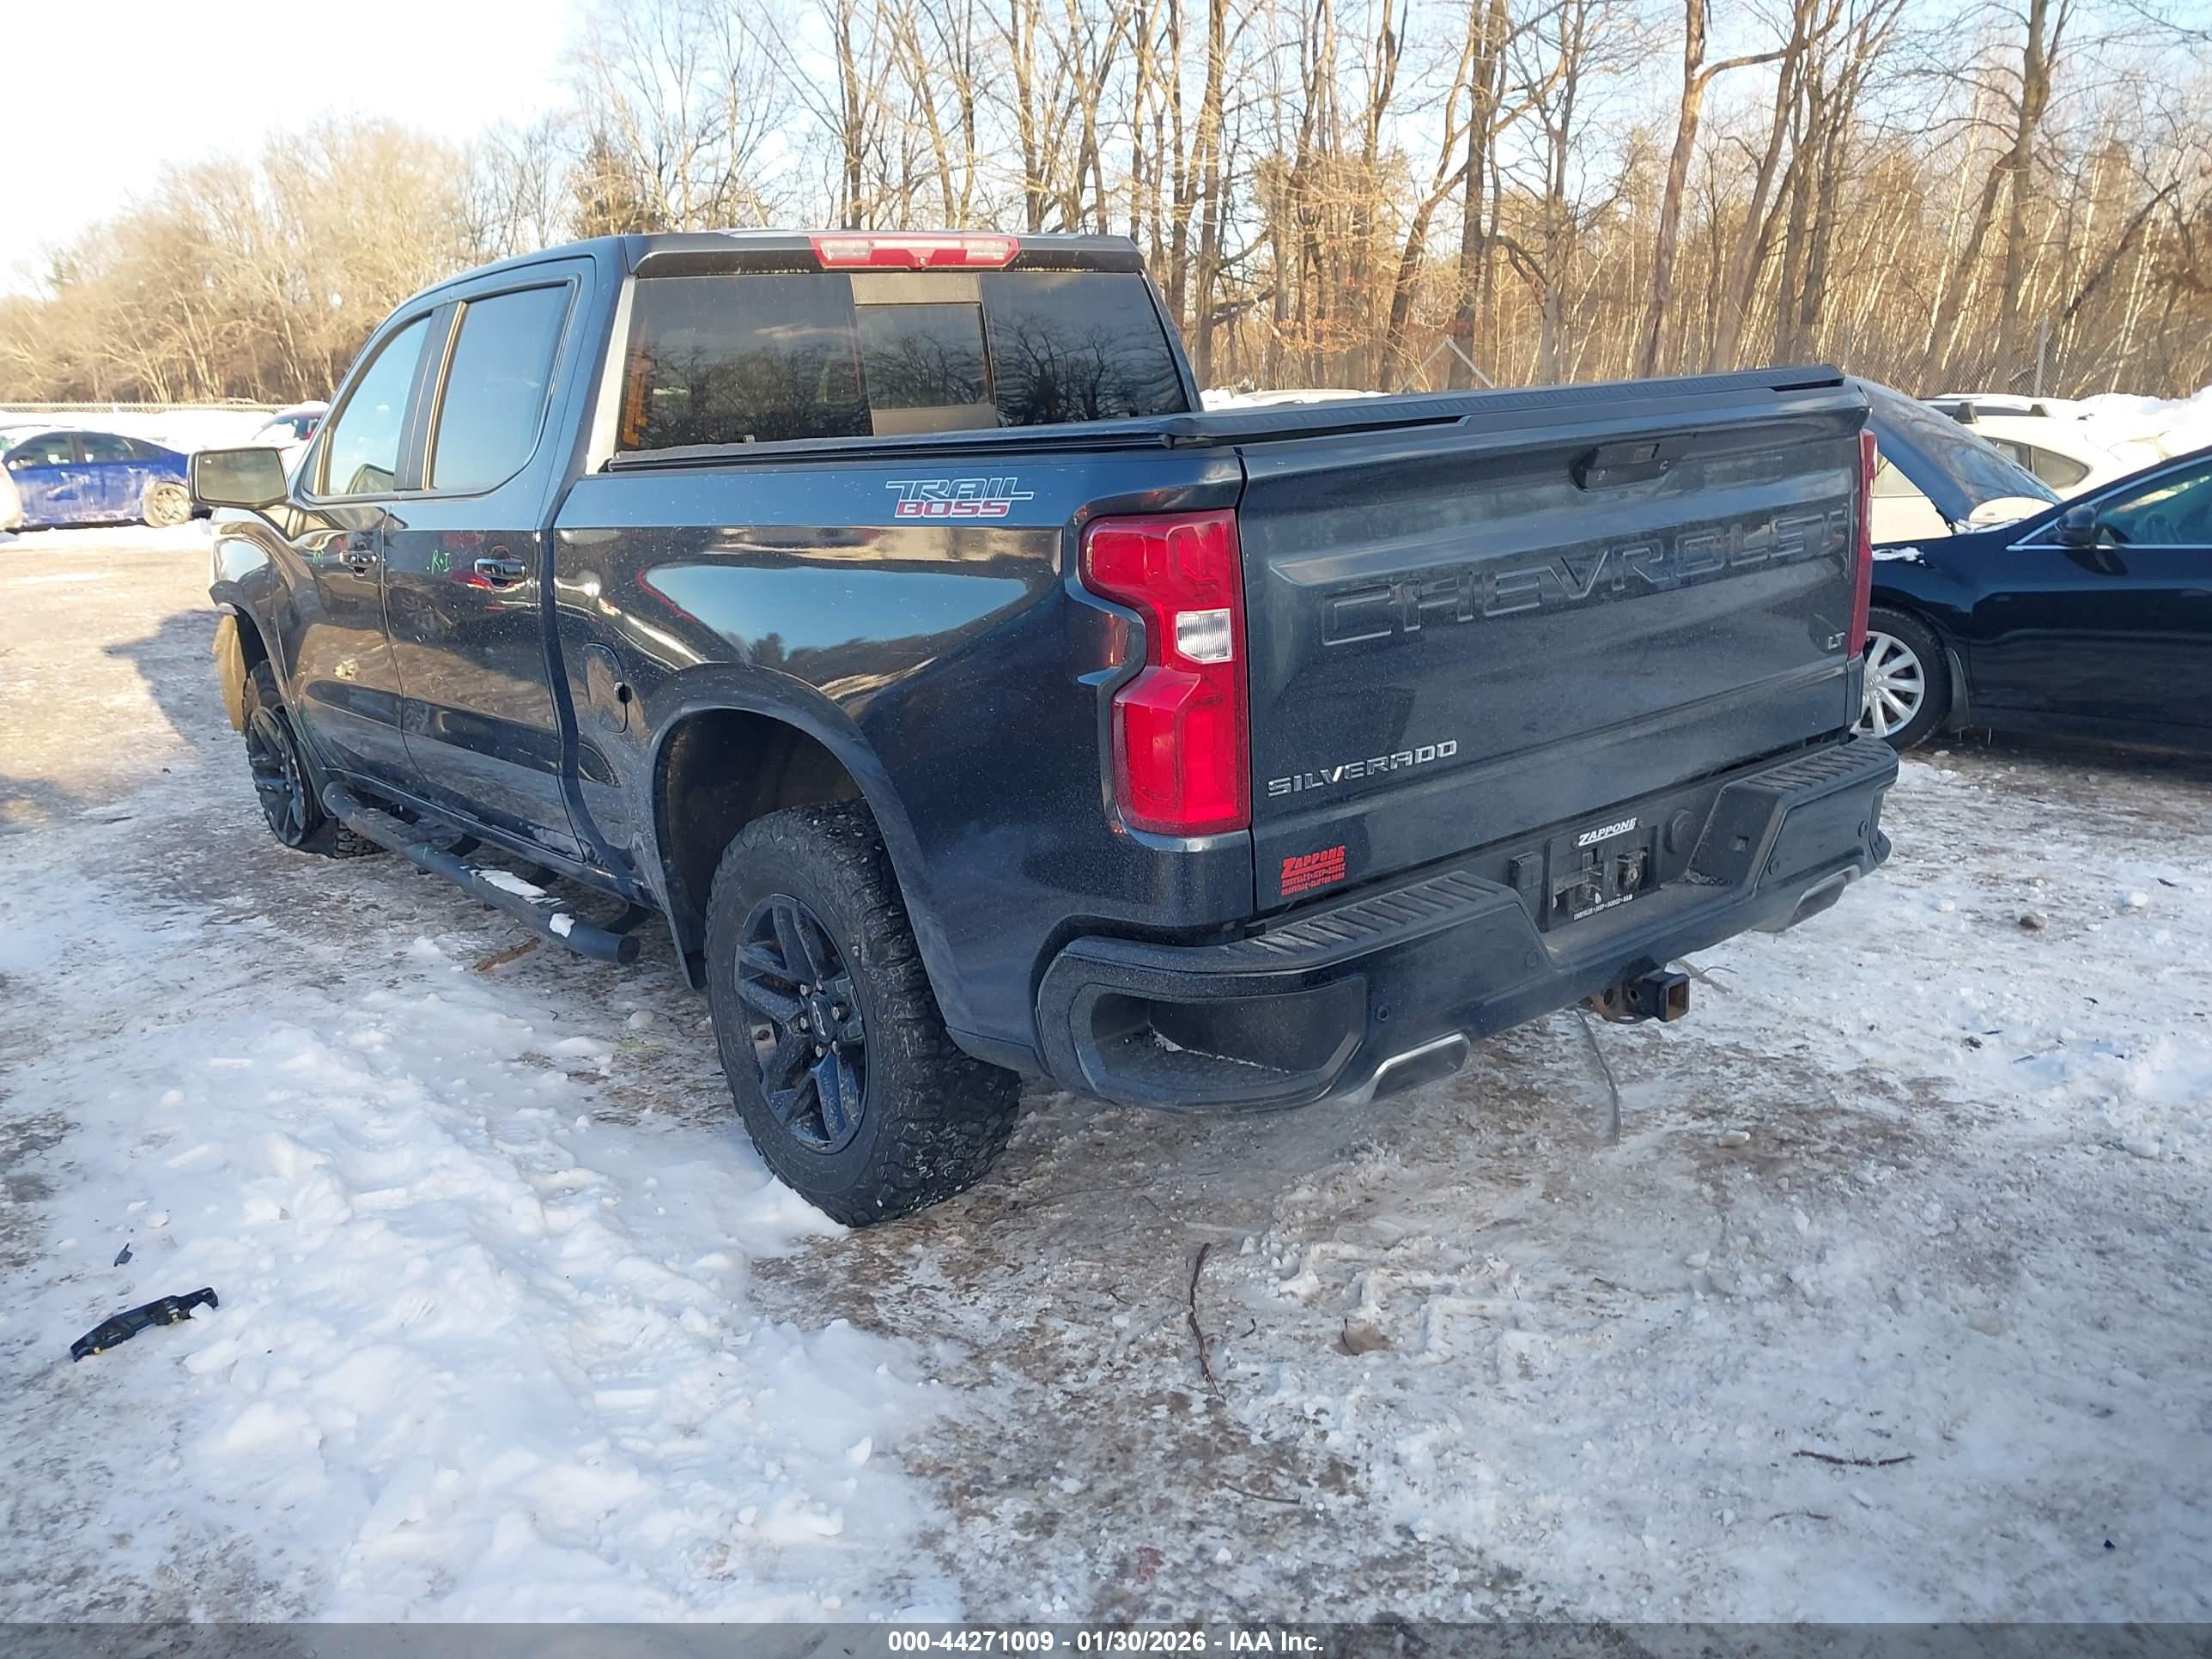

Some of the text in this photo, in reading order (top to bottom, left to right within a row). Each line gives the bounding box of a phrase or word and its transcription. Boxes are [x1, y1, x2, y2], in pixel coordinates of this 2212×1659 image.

[885, 477, 1035, 501] TRAIL
[894, 499, 1011, 519] BOSS
[1322, 504, 1849, 647] CHEVROLET
[1827, 631, 1846, 650] LT
[1267, 739, 1458, 798] SILVERADO
[1578, 817, 1638, 847] ZAPPONE
[1281, 845, 1346, 879] ZAPPONE
